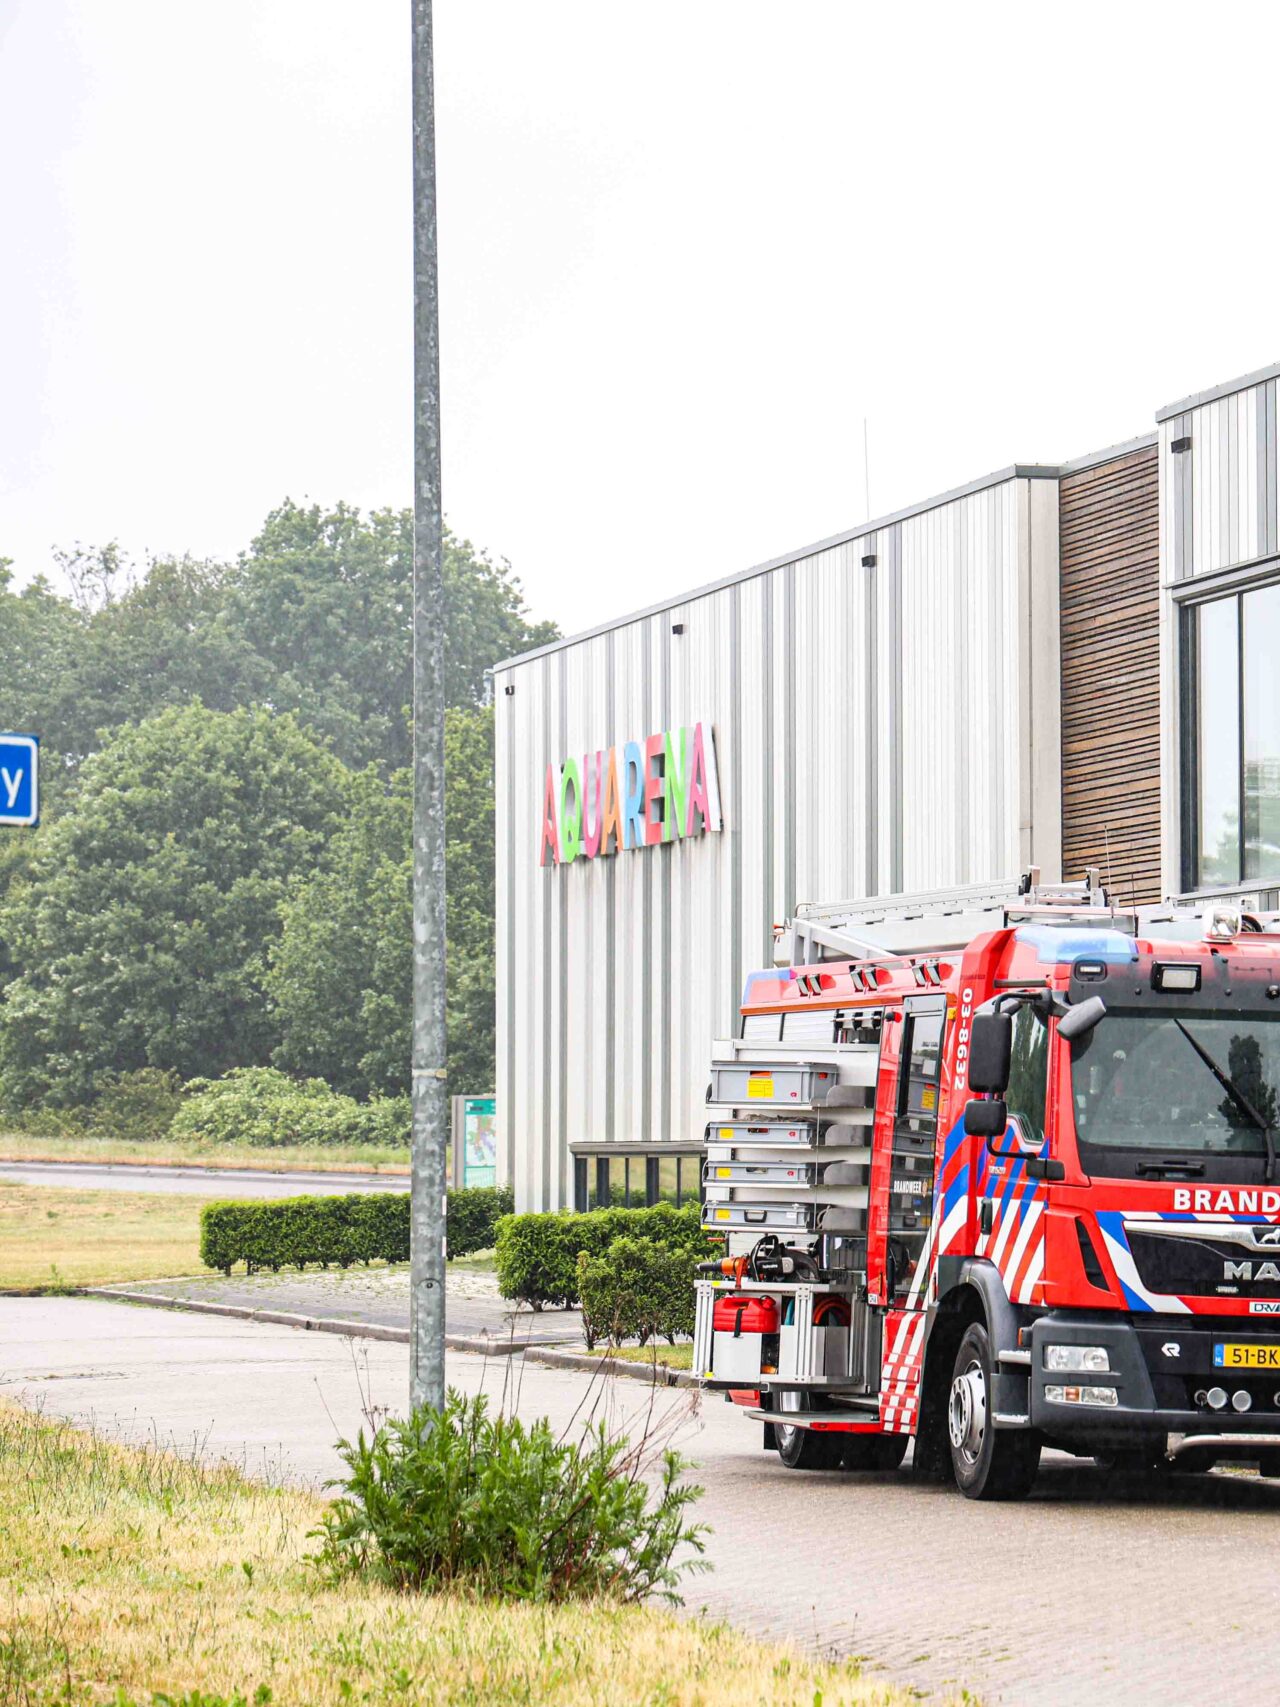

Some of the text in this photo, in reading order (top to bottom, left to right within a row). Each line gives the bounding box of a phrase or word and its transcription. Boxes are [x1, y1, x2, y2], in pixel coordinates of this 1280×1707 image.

[540, 721, 718, 867] AQUARENA
[954, 988, 973, 1090] 03-8632
[893, 1180, 922, 1194] BRANDWEER
